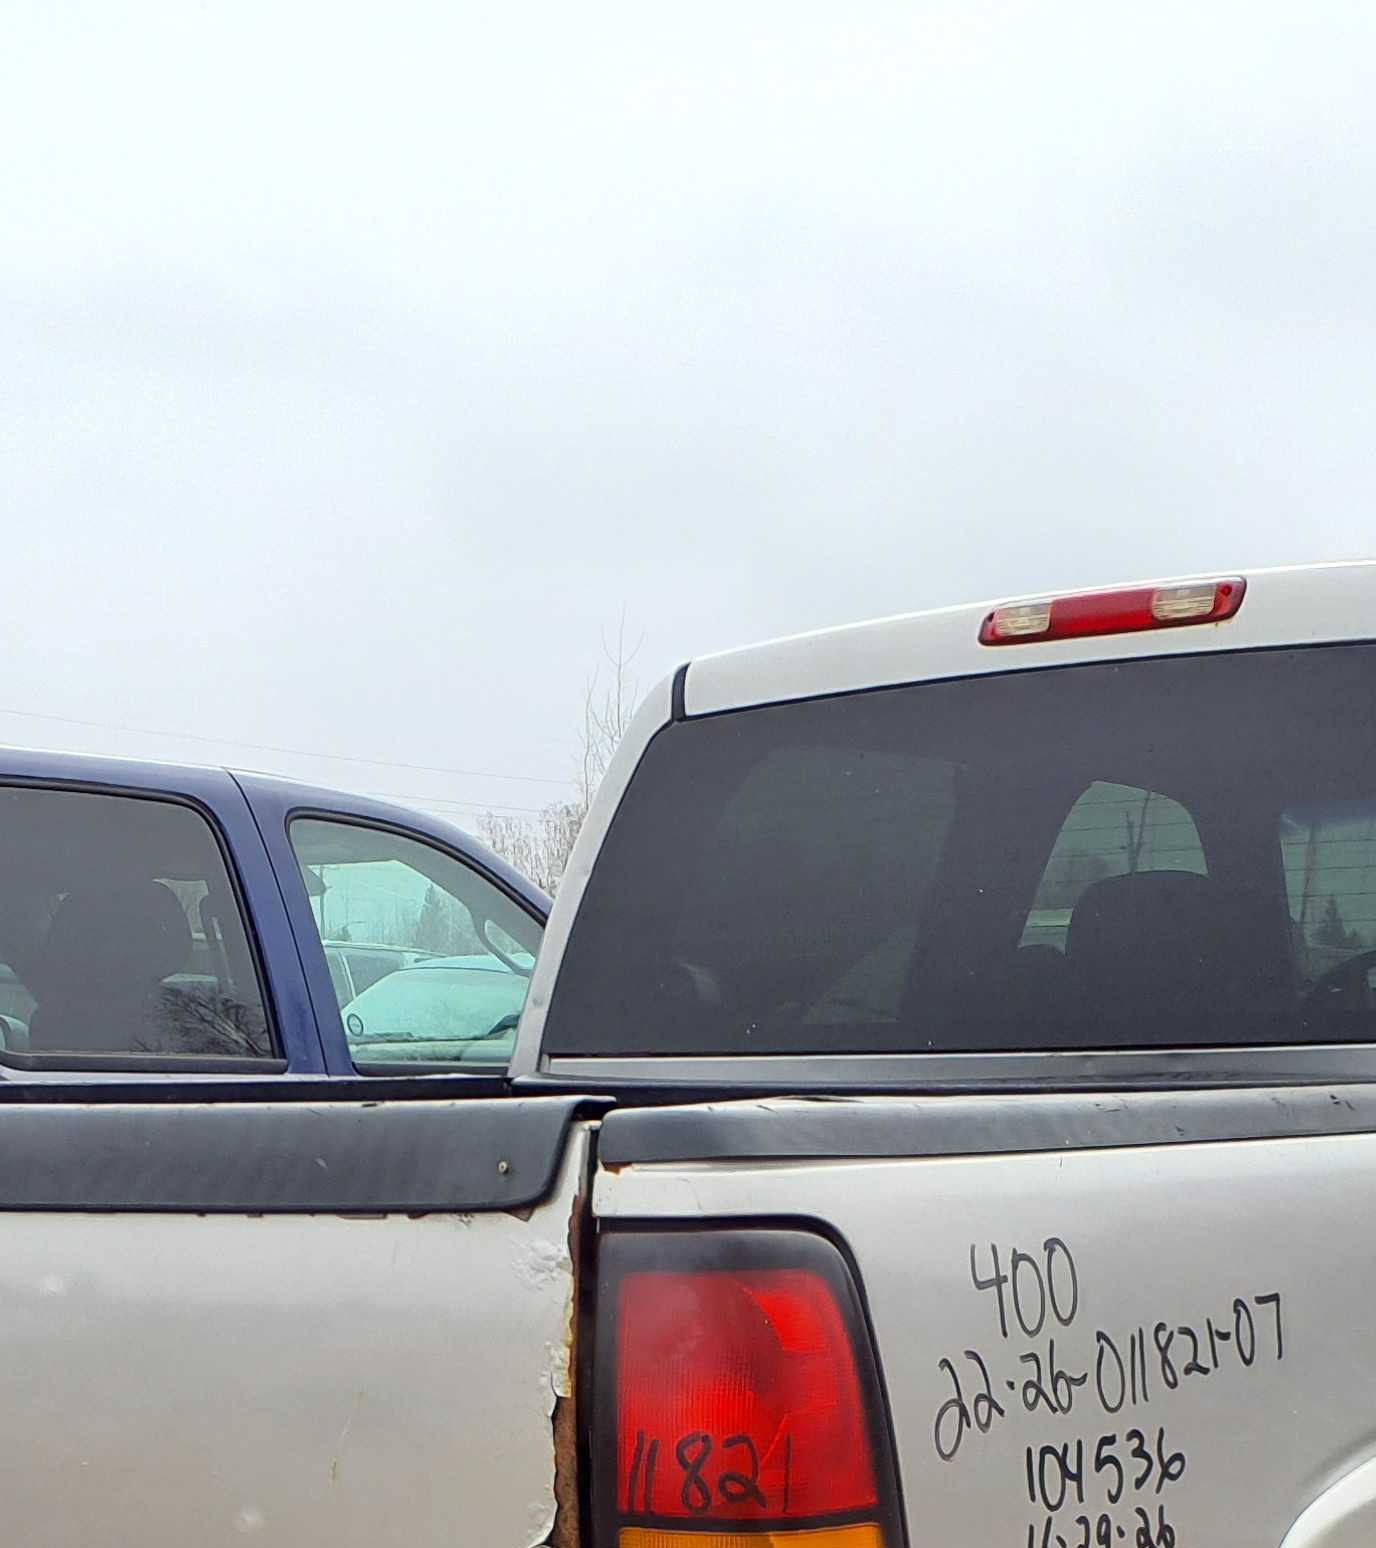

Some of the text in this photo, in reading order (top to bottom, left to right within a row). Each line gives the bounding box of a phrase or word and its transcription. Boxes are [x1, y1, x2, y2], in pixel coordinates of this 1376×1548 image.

[969, 1236, 1079, 1339] 400
[626, 1429, 792, 1515] 11821
[1026, 1426, 1186, 1512] 104536
